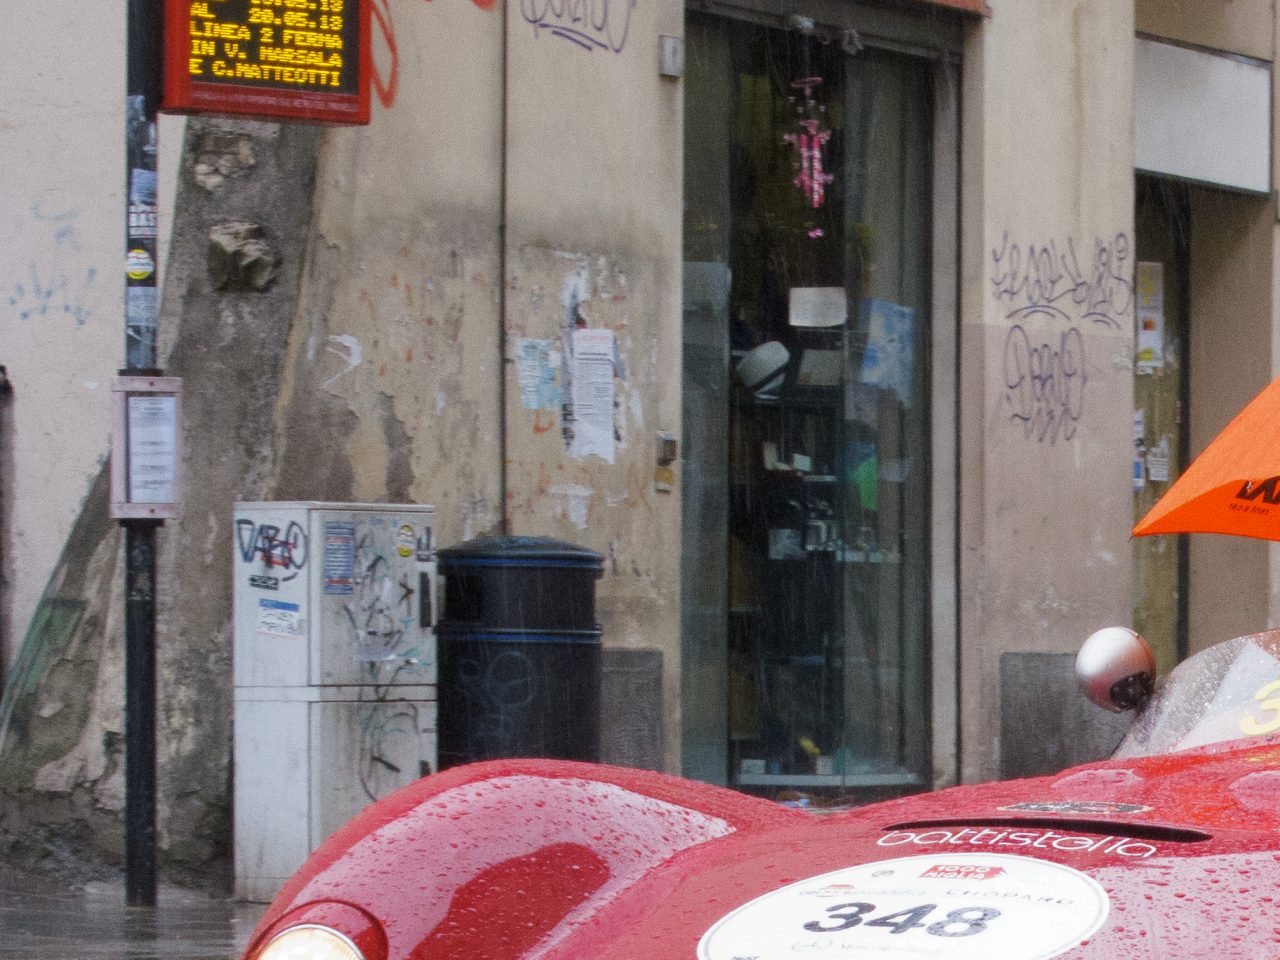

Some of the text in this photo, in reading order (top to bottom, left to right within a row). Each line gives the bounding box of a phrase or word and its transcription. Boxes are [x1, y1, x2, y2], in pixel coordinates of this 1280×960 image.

[190, 2, 215, 18] AL
[190, 20, 343, 49] LINEA 2 FERMA
[191, 40, 215, 56] IN
[259, 46, 343, 68] MARSALA
[189, 58, 341, 86] E C.MATTEOTTI
[877, 828, 1157, 858] battistella
[926, 871, 986, 880] MIGLIA
[937, 865, 991, 873] 1000
[946, 888, 1074, 906] CHOPARD
[803, 901, 1002, 937] 348
